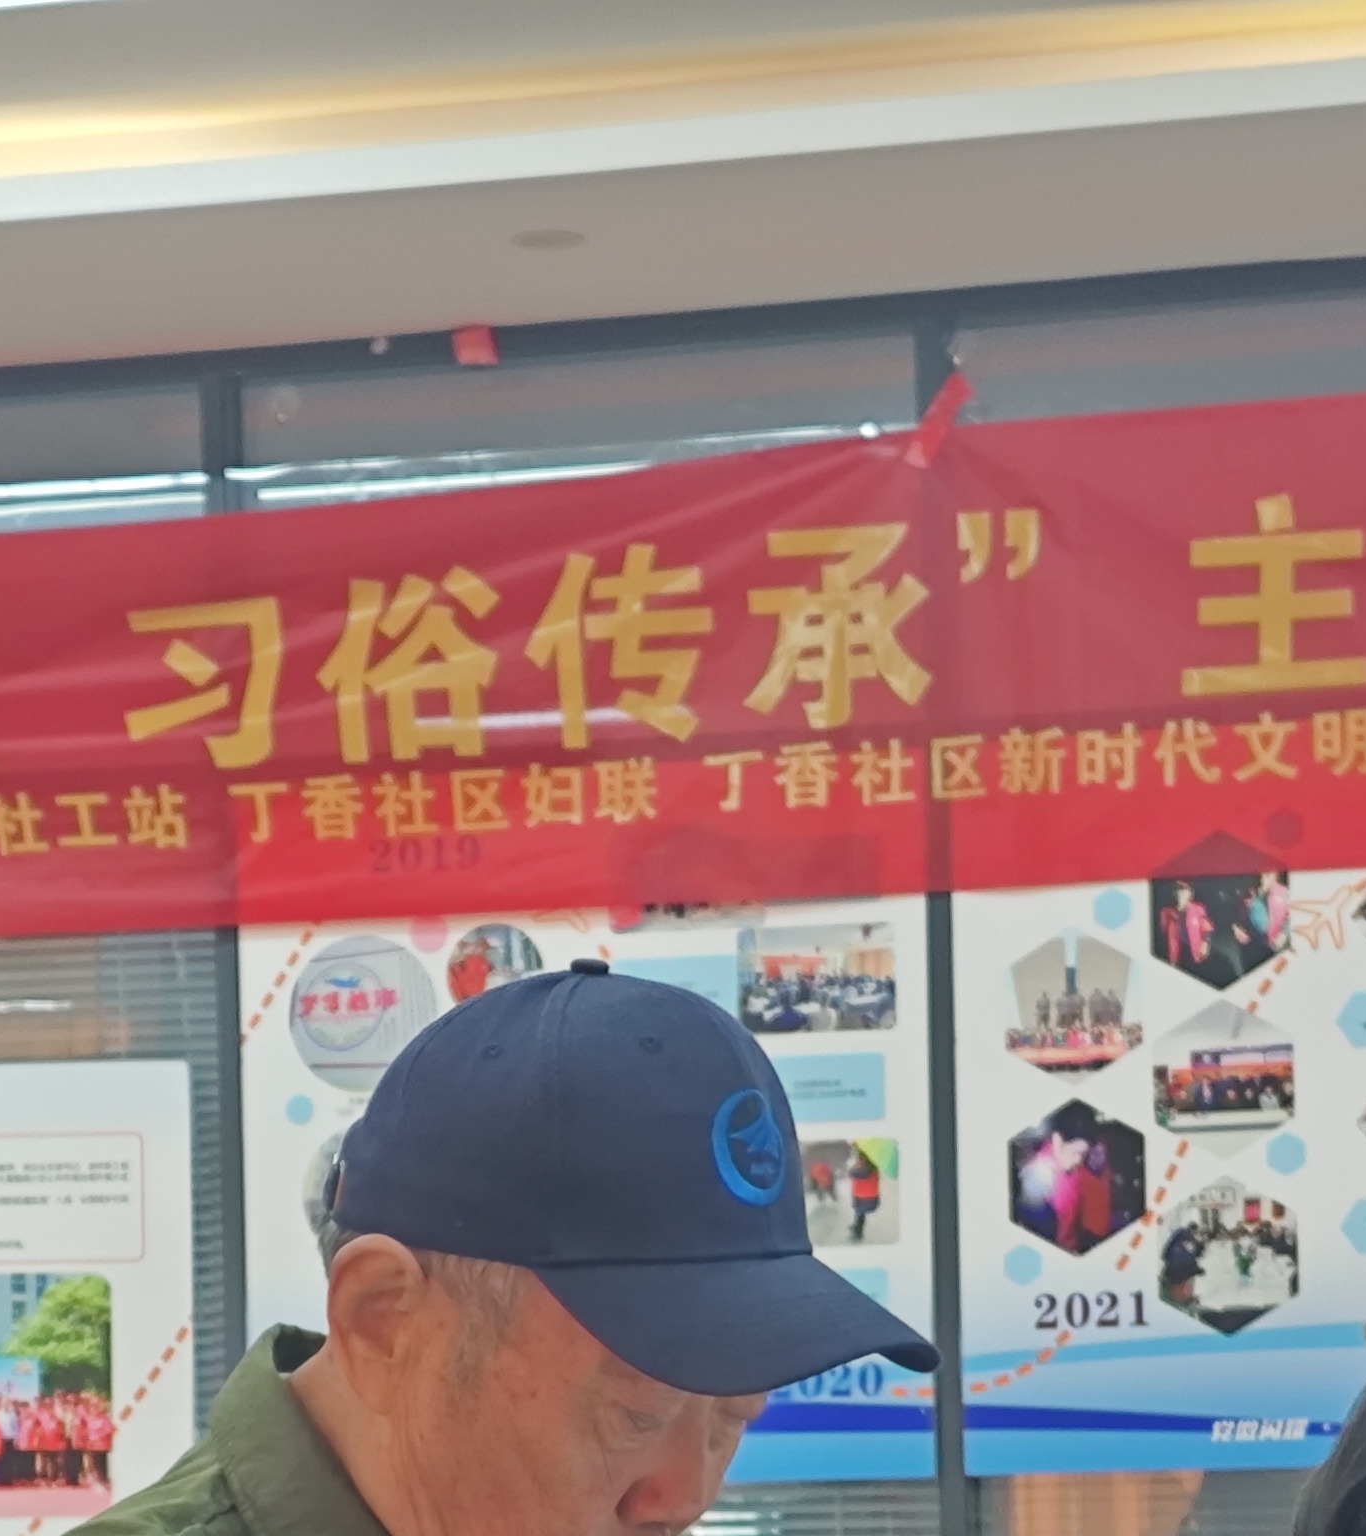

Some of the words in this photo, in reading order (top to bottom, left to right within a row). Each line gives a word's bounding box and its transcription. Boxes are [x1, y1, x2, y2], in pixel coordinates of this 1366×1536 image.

[123, 508, 1043, 771] 习俗传承”
[229, 758, 659, 842] 丁香社区妇联
[369, 833, 481, 874] 2019
[1034, 1289, 1150, 1330] 2021
[772, 1362, 884, 1398] 020
